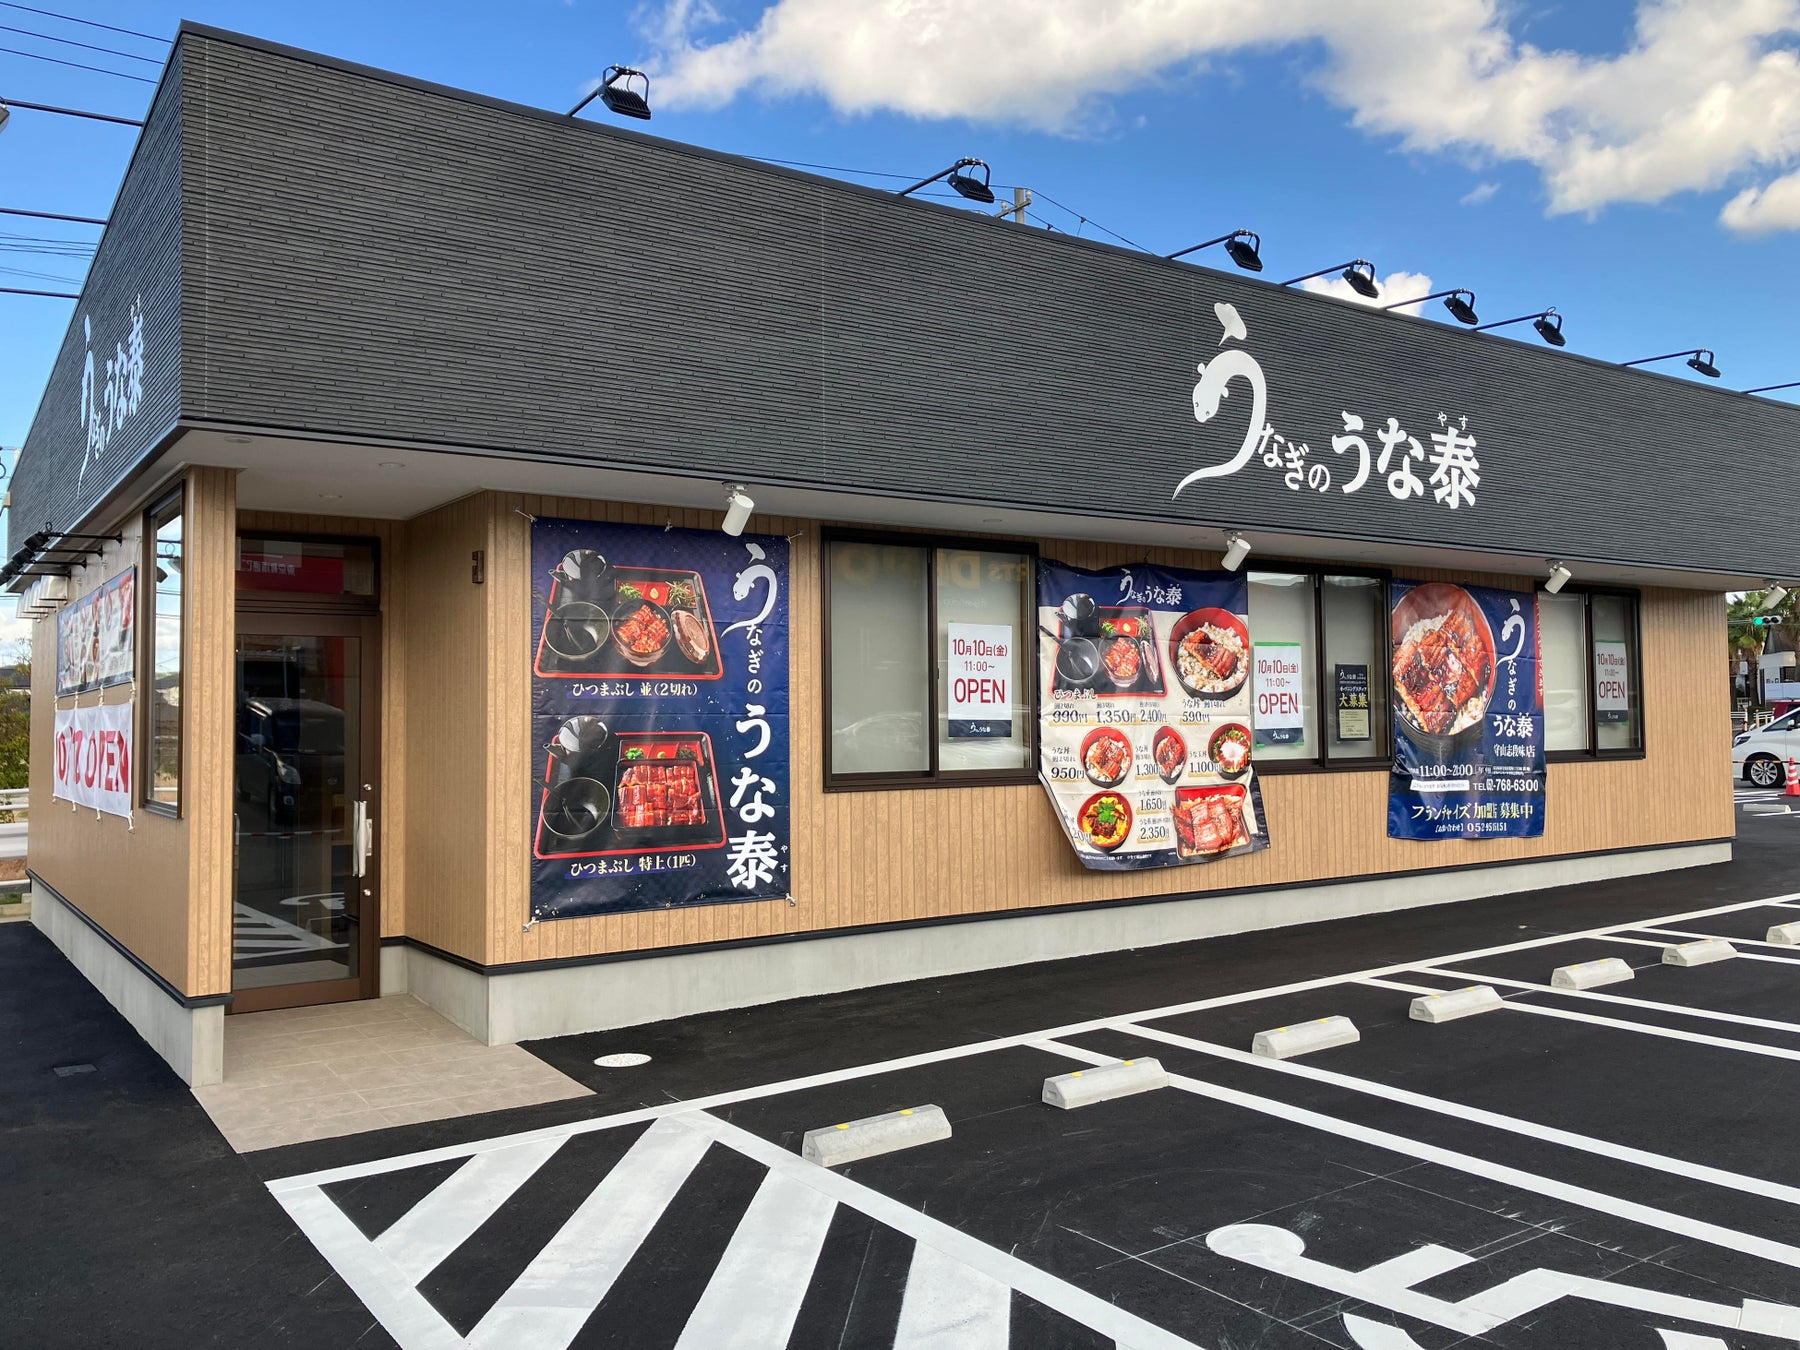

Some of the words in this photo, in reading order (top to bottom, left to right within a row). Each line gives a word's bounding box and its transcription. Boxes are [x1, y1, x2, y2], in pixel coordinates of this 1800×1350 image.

[952, 639, 1008, 657] 10月10日(金)
[1258, 659, 1299, 674] 10月10日(金)
[572, 683, 634, 698] ひつまぶし
[954, 678, 1006, 704] OPEN
[1054, 688, 1096, 701] ひつまぶし
[1599, 681, 1625, 699] OPEN
[1259, 692, 1299, 715] OPEN
[1339, 693, 1368, 709] 大募集
[1493, 715, 1534, 738] うな泰
[84, 730, 129, 793] OPEN
[1051, 766, 1085, 780] 950円
[1411, 802, 1470, 822] フランチャイズ
[1500, 802, 1533, 819] 募集中
[570, 860, 634, 876] ひつまぶし
